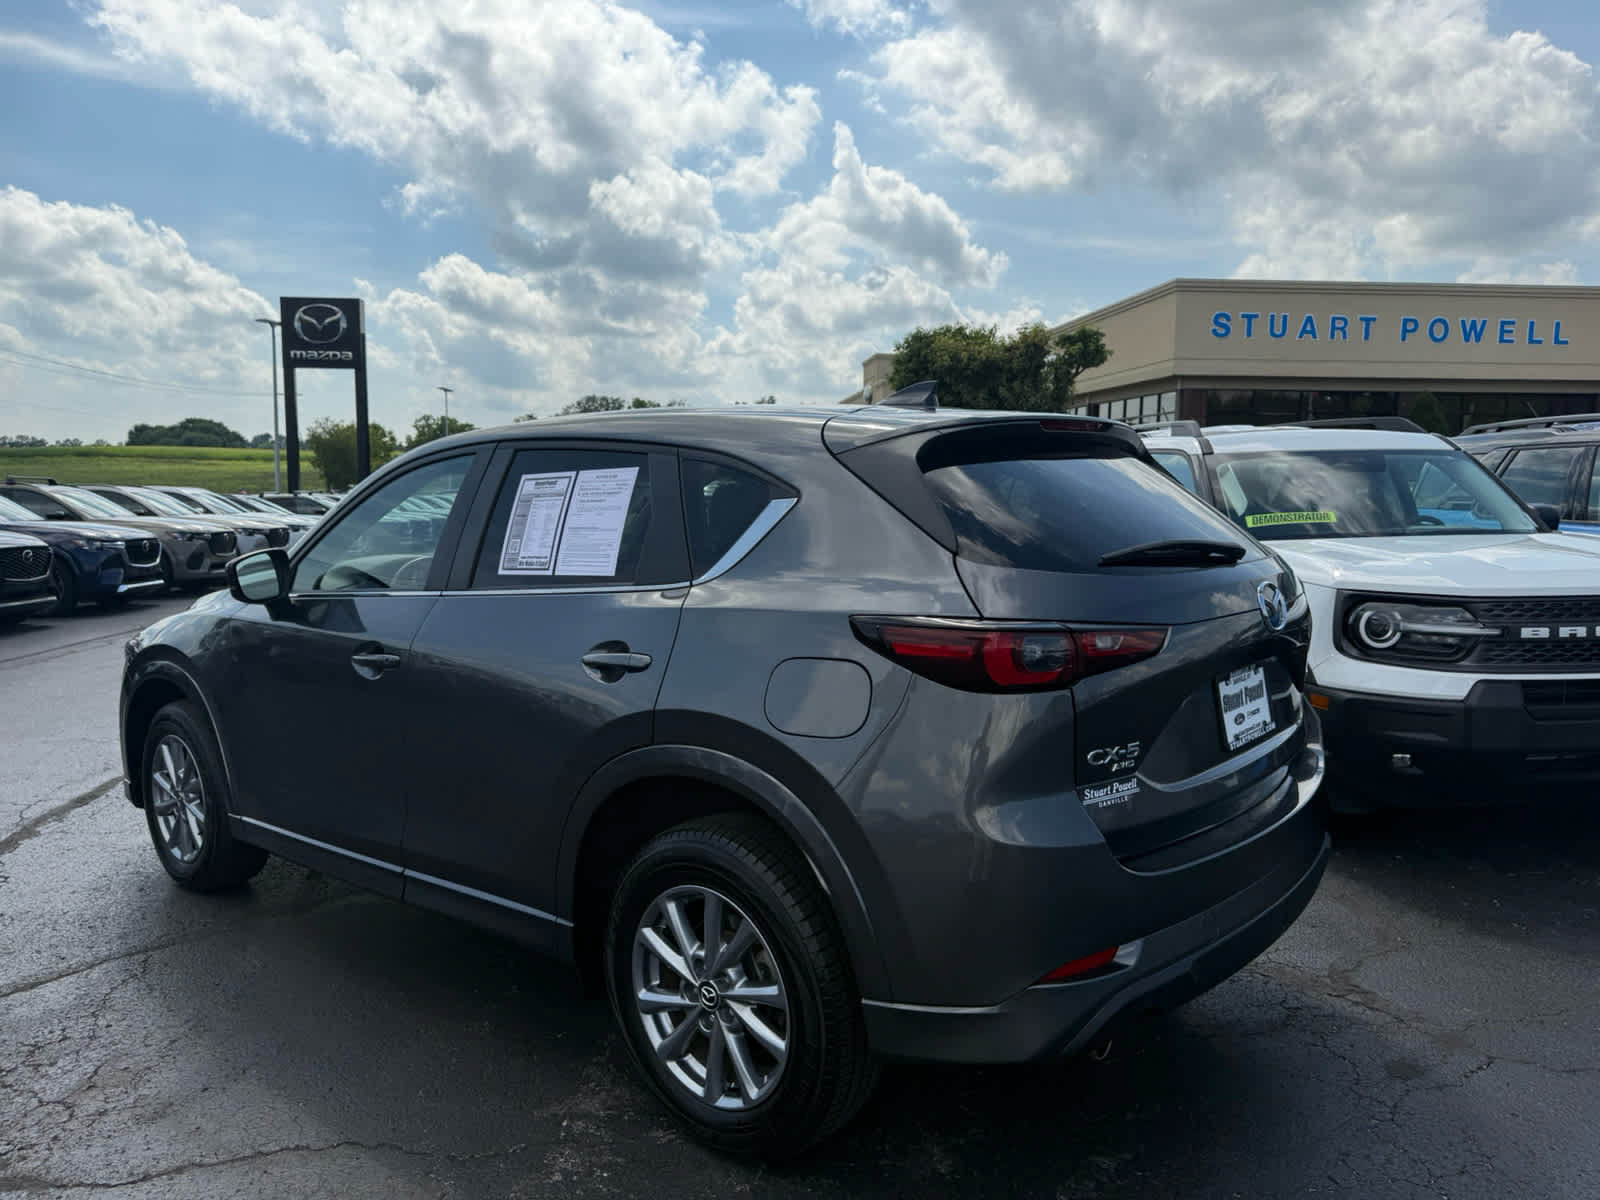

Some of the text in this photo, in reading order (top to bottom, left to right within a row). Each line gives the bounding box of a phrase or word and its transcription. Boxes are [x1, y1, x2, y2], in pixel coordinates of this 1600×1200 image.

[1211, 311, 1569, 345] STUART POWELL
[1251, 511, 1330, 526] DEMONSTRATOR
[1520, 626, 1600, 638] BR
[1087, 741, 1140, 765] CX-5
[1084, 777, 1137, 800] Stuart Powell
